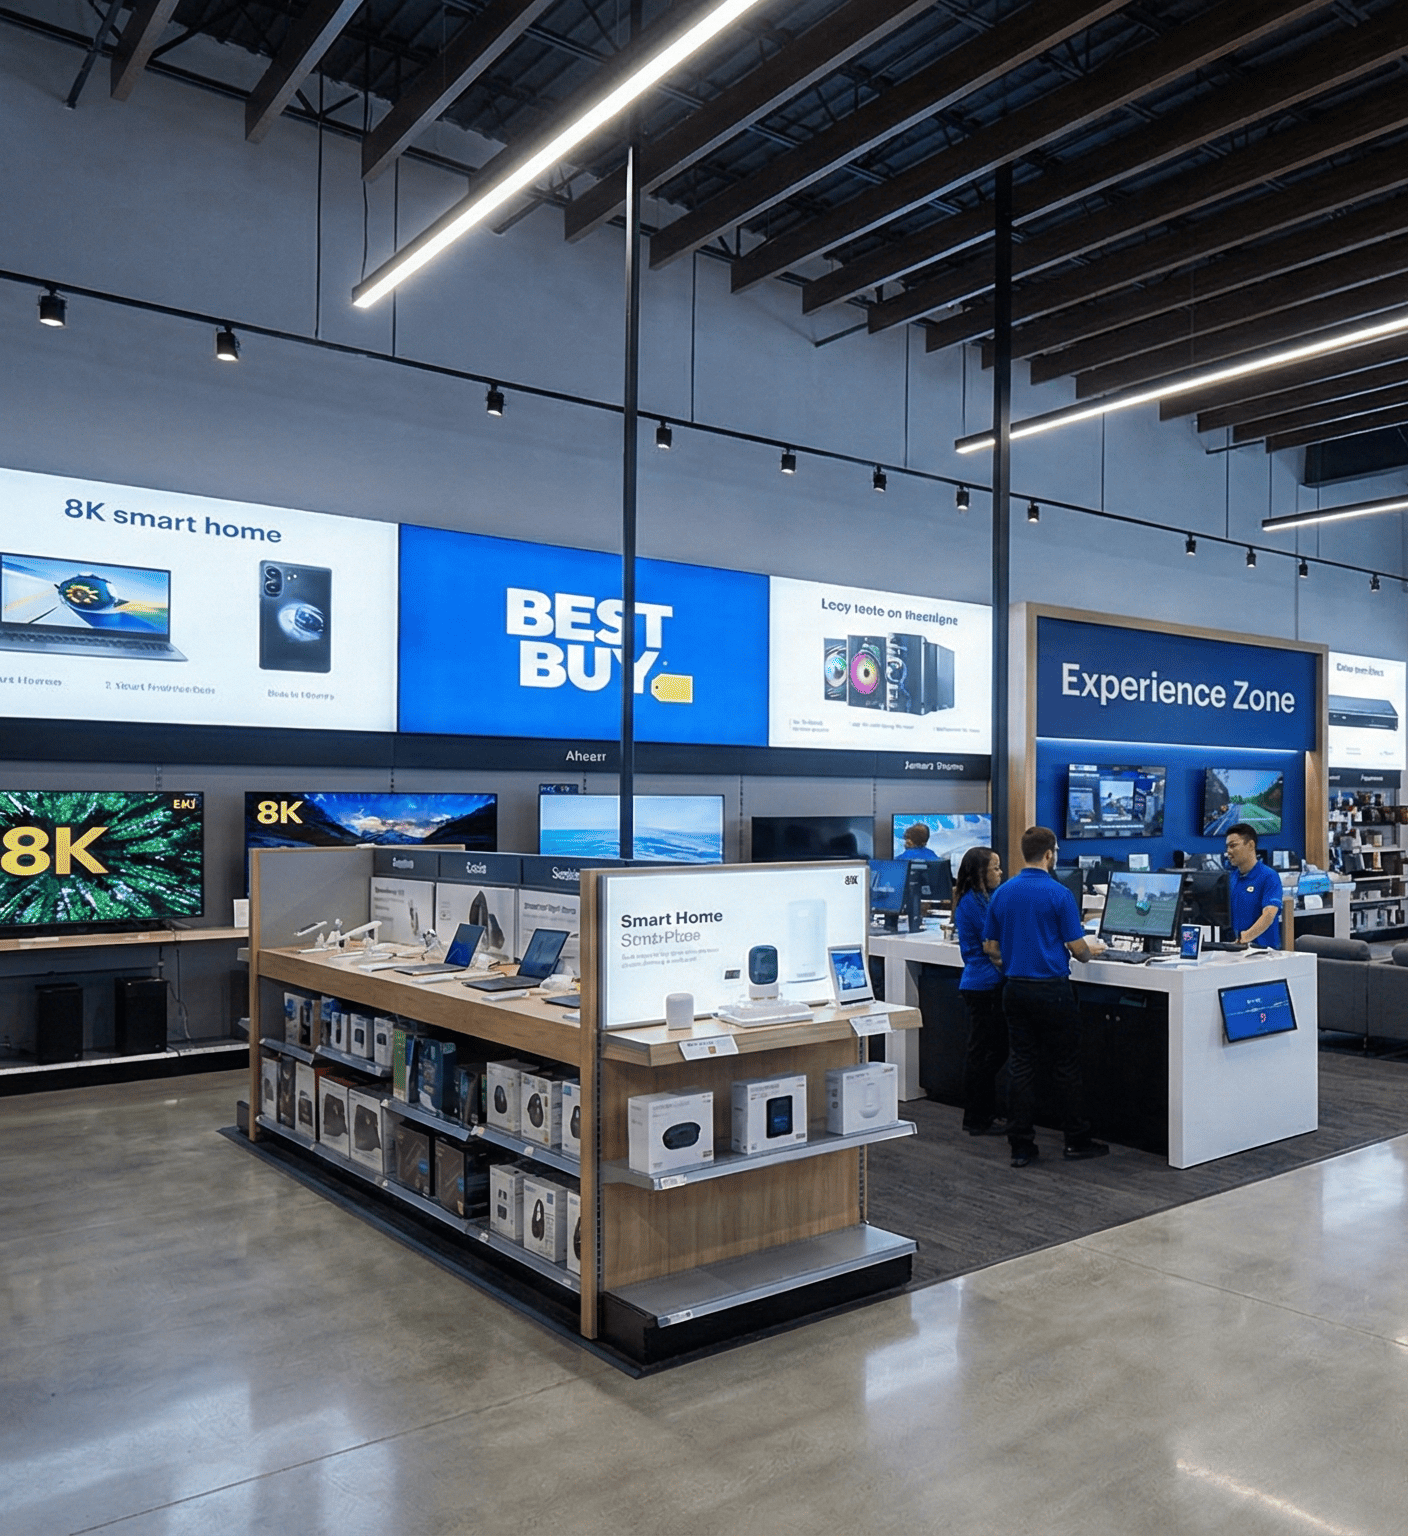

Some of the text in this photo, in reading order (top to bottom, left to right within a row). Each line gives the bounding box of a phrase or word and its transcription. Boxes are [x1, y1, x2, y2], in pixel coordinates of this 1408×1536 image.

[64, 498, 282, 543] 8K smart home
[506, 587, 673, 649] BEST
[887, 609, 902, 619] on
[519, 640, 660, 694] BUY
[1062, 662, 1295, 714] Experience Zone
[257, 800, 304, 824] 8K
[0, 826, 109, 876] 8K
[620, 911, 723, 928] Smart Home
